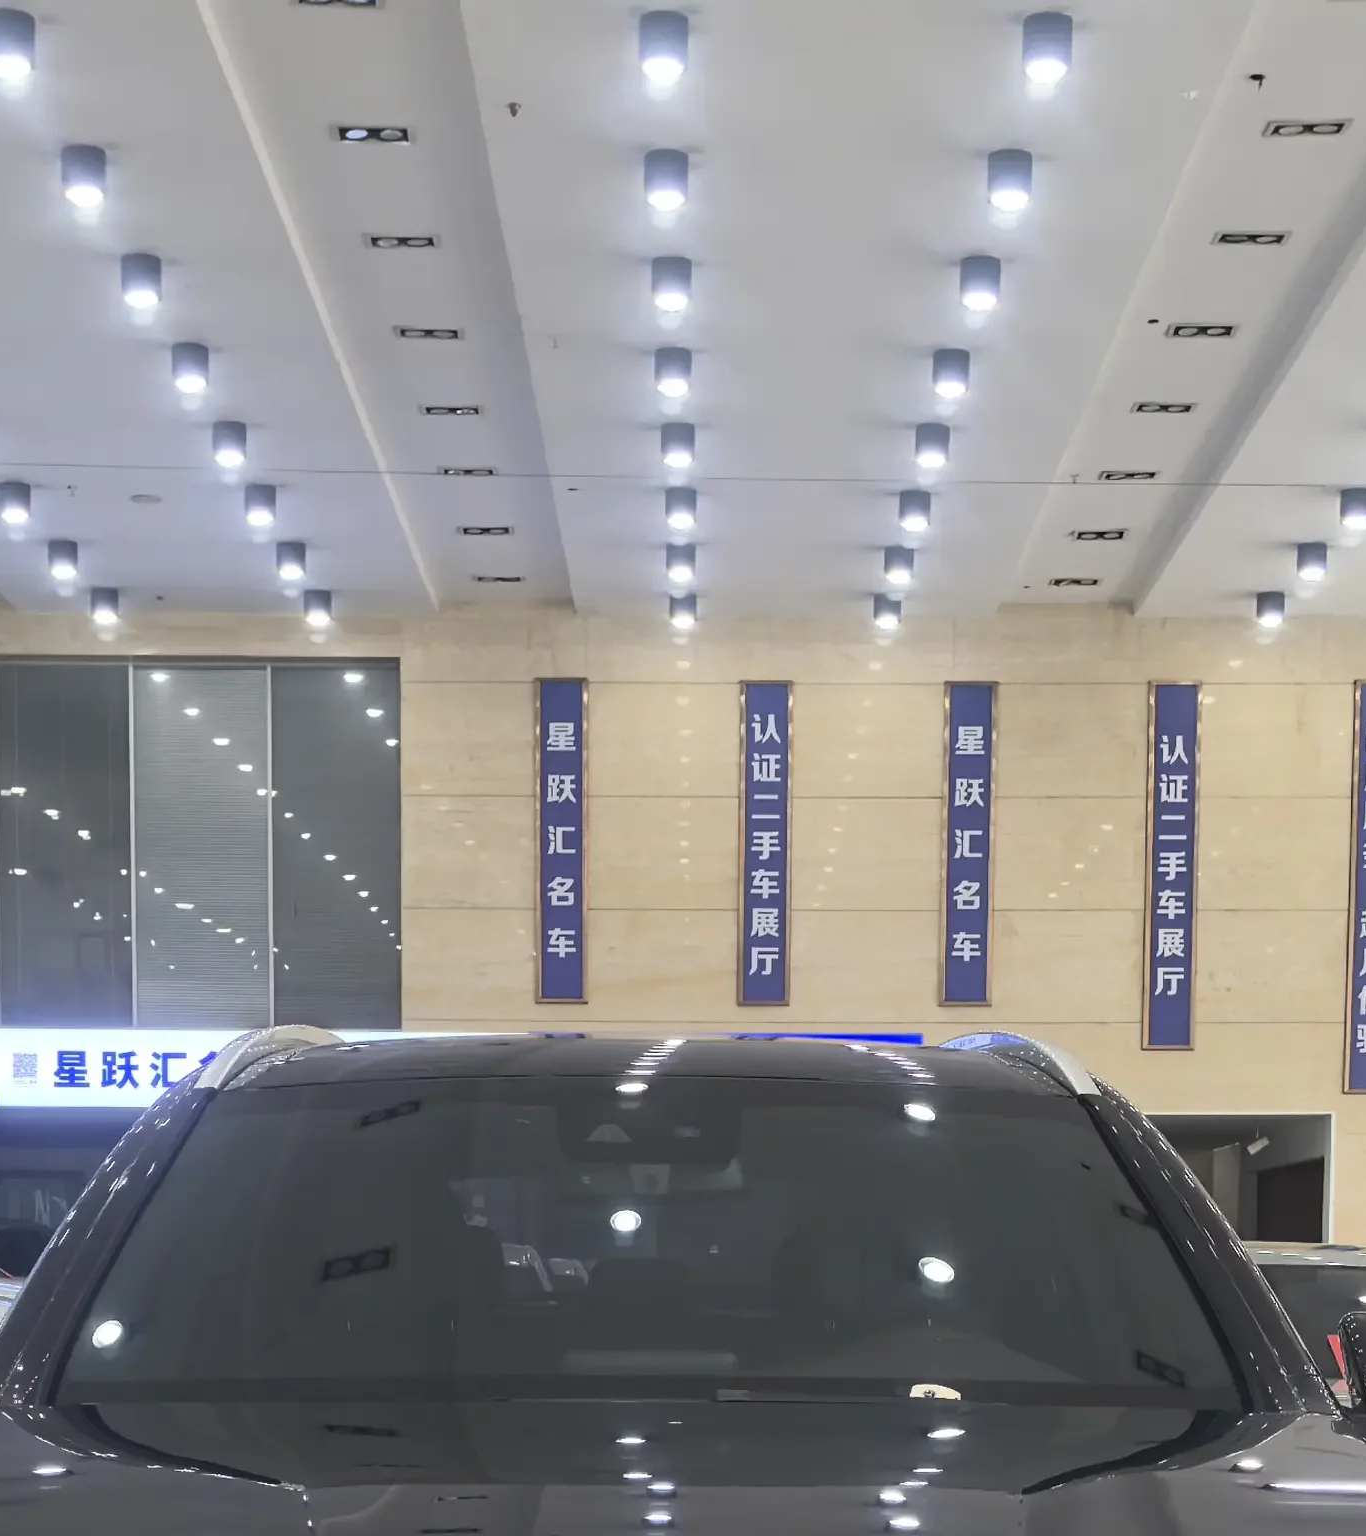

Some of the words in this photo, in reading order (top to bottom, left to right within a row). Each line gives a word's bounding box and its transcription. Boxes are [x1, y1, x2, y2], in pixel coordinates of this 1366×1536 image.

[546, 722, 577, 958] 星跃汇名车
[748, 713, 782, 976] 认证二手车展厅
[952, 725, 986, 962] 星跃汇名车
[1154, 735, 1189, 996] 认证二手车展厅
[53, 1050, 219, 1089] 星跃汇
